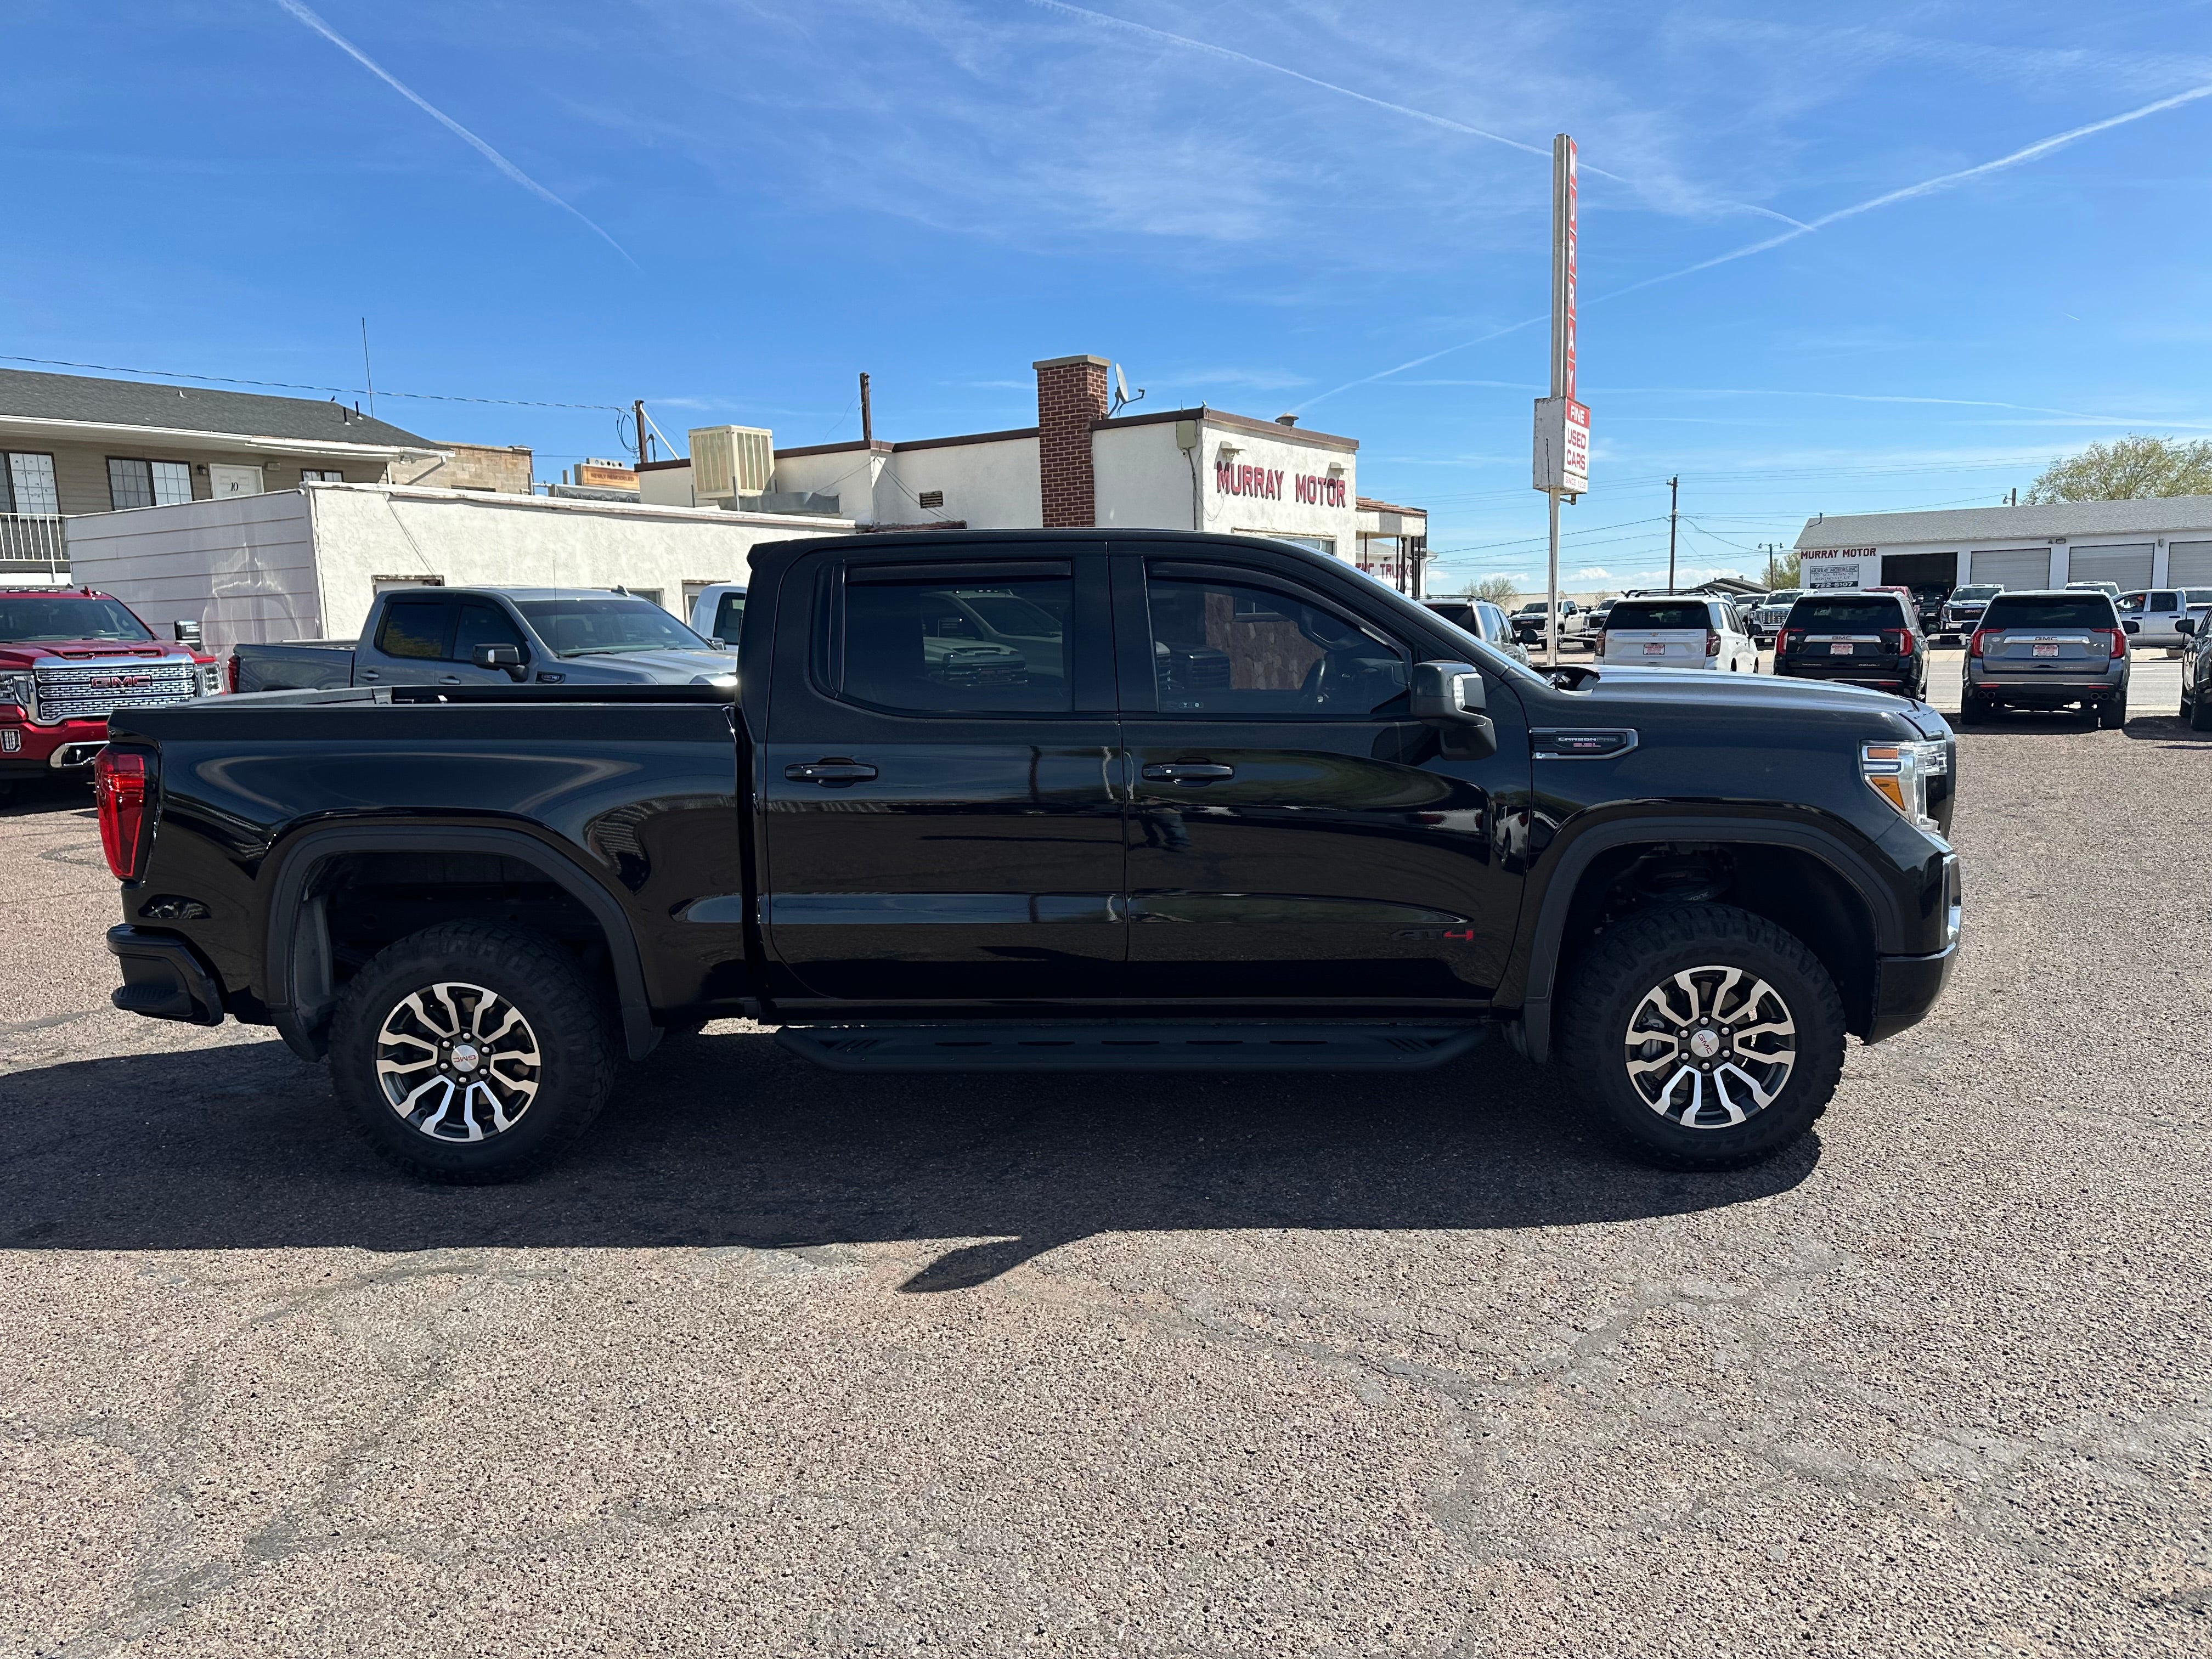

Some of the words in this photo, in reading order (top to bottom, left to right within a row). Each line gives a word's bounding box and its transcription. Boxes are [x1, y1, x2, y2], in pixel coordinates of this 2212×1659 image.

[1570, 405, 1585, 425] FINE
[1567, 427, 1586, 449] USED
[1567, 449, 1585, 470] CARS
[230, 482, 239, 492] 10
[1217, 460, 1284, 501] MURRAY
[1295, 473, 1346, 508] MOTOR
[1565, 476, 1576, 486] SINCE
[1801, 550, 1838, 559] MURRAY
[1843, 548, 1876, 557] MOTOR
[91, 675, 151, 688] GMC
[1697, 1033, 1713, 1054] GMC
[453, 1054, 476, 1063] GMC
